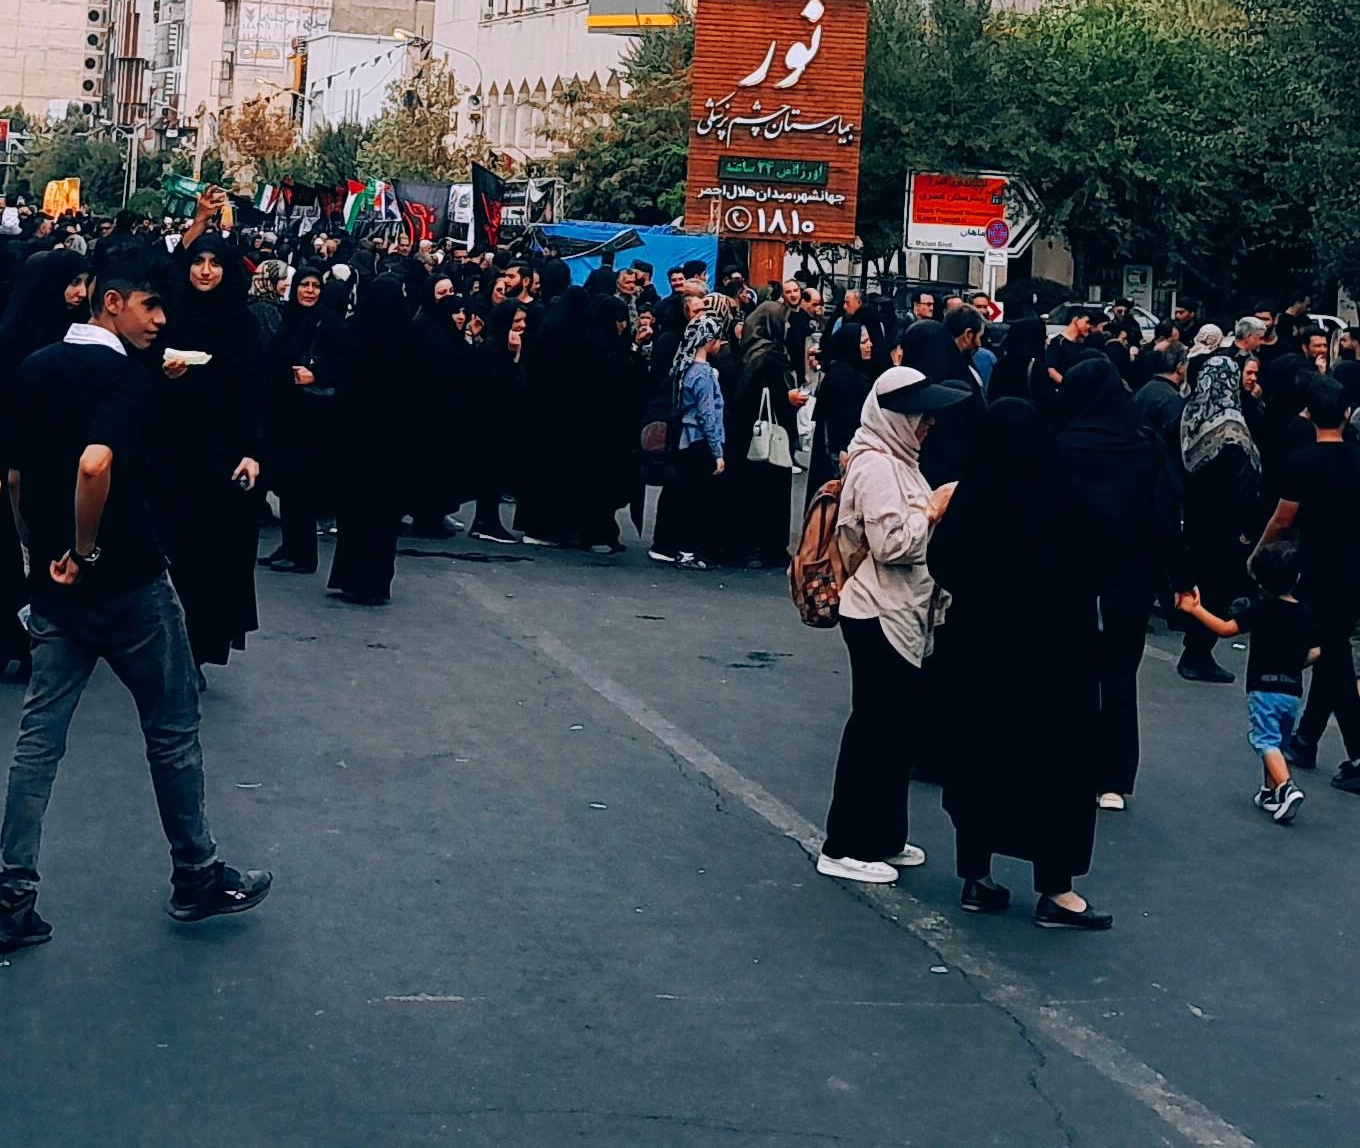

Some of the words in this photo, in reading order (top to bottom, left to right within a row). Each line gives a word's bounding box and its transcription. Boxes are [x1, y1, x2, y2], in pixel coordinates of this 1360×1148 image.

[696, 90, 737, 141] پزشکی
[726, 100, 792, 148] چشم
[764, 108, 854, 144] بیمارستان
[697, 184, 727, 199] احمر
[726, 184, 756, 200] هلال
[756, 186, 792, 203] میدان
[757, 207, 816, 235] ۱۸۱۰
